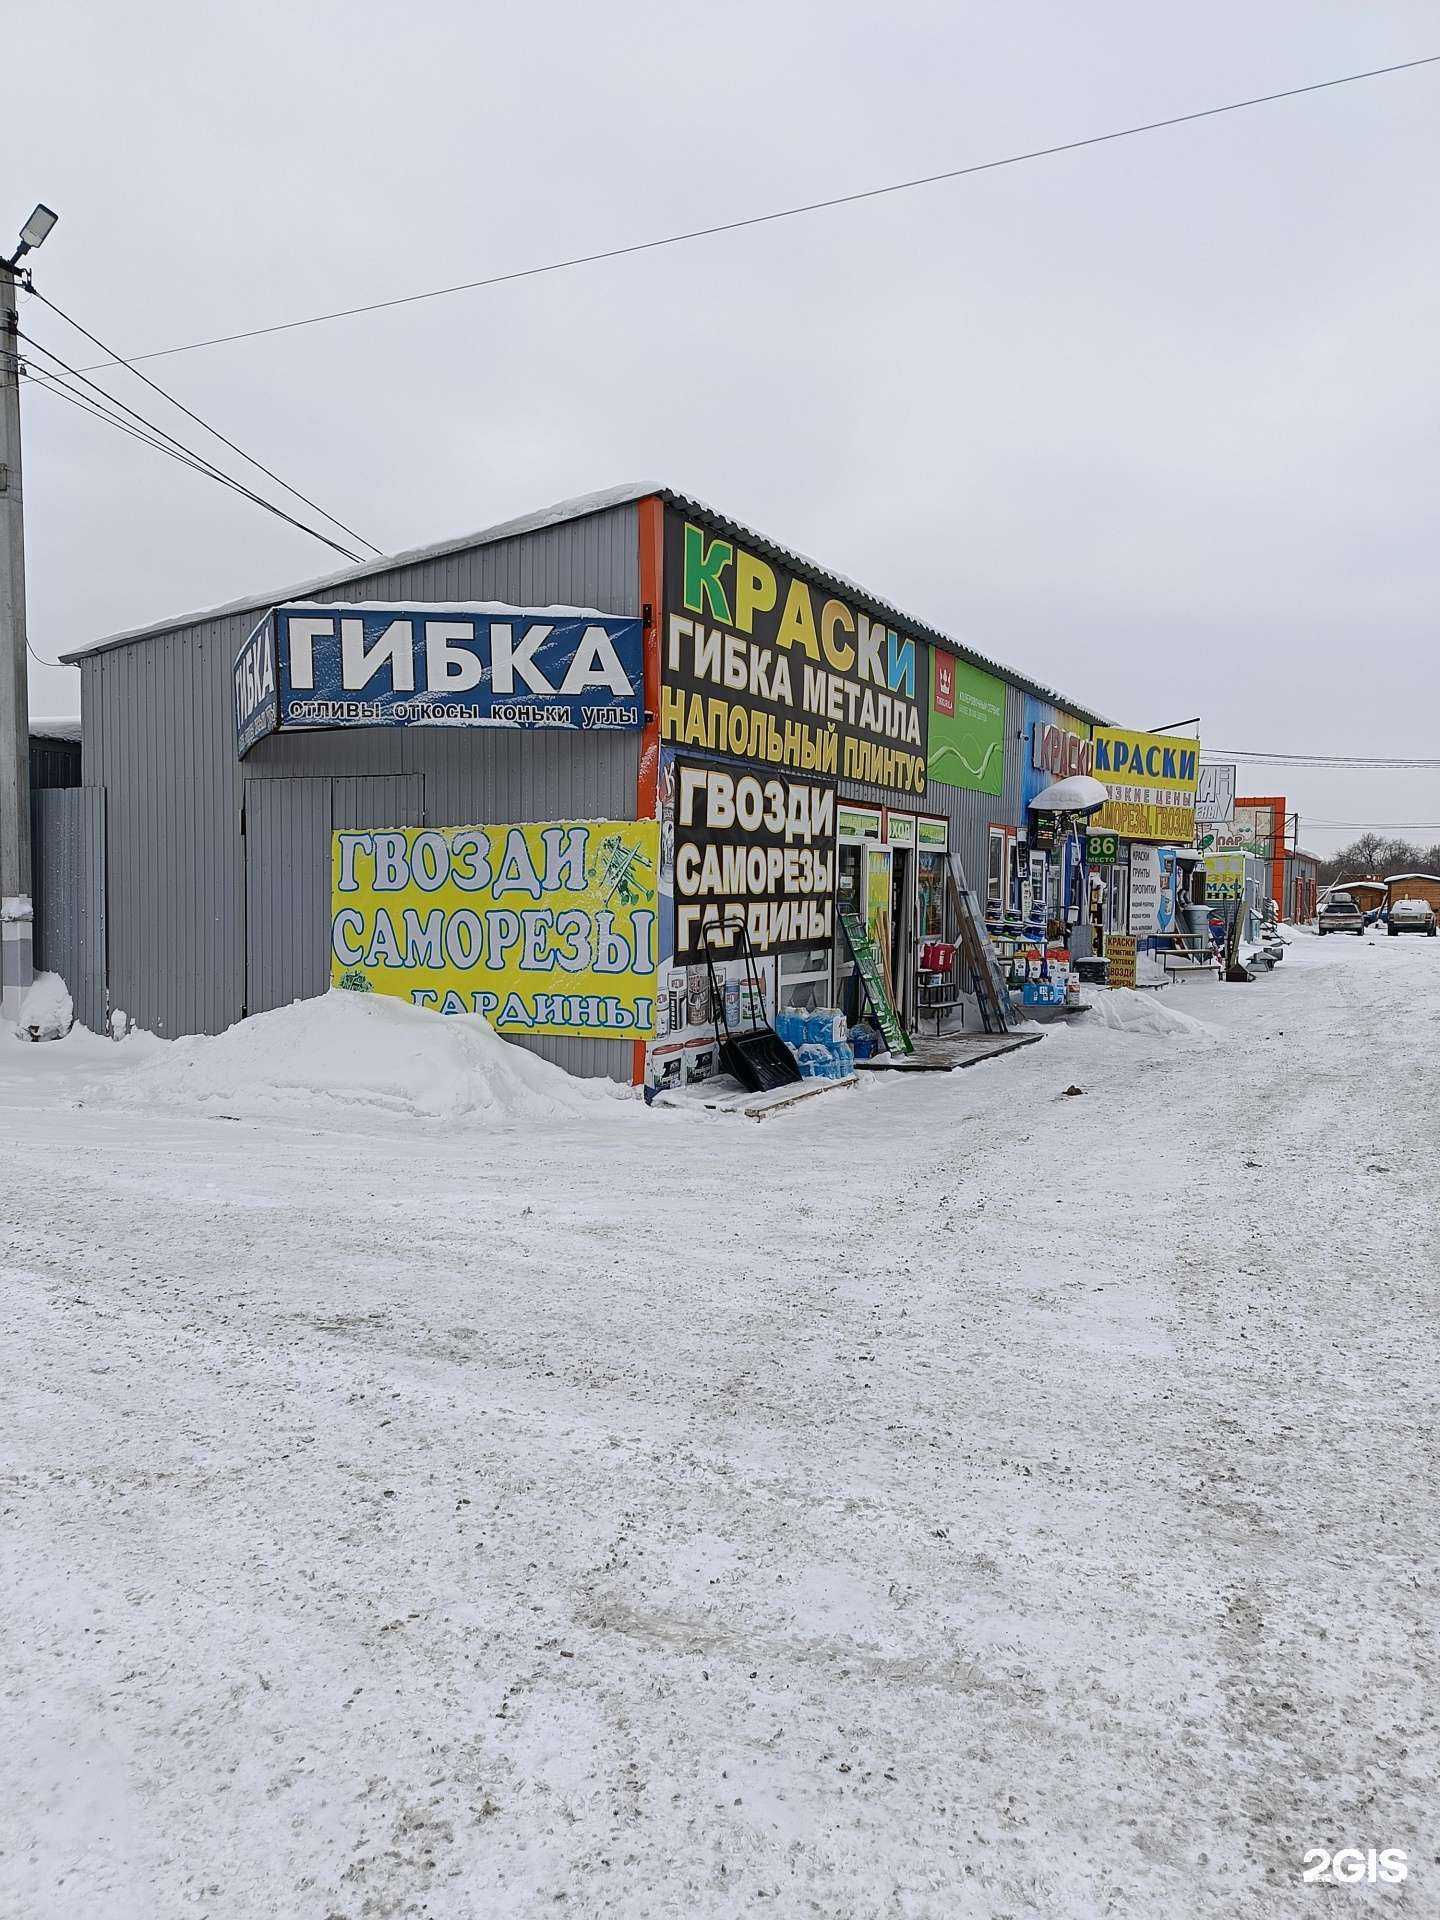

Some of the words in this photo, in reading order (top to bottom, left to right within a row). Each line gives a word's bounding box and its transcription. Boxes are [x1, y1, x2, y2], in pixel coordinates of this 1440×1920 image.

[684, 522, 916, 699] КРАСКИ
[288, 618, 636, 696] ГИБКА
[668, 613, 794, 707] ГИБКА
[802, 663, 921, 747] МЕТАЛЛА
[661, 685, 838, 777] НАПОЛЬНЫЙ
[843, 735, 926, 794] ПЛИНТУС
[1095, 736, 1196, 781] КРАСКИ
[678, 765, 835, 845] ГВОЗДИ
[1105, 785, 1150, 804] ИЗКИЕ
[1155, 789, 1192, 807] ЦЕНЫ
[337, 827, 590, 900] ГВОЗДИ
[675, 842, 834, 897] САМОРЕЗЫ
[1089, 837, 1115, 855] 86
[331, 908, 655, 974] САМОРЕЗЫ
[677, 899, 833, 952] ГАРДИНЫ
[1107, 937, 1136, 947] КРАСКИ
[1110, 967, 1134, 978] ВОЗДИ
